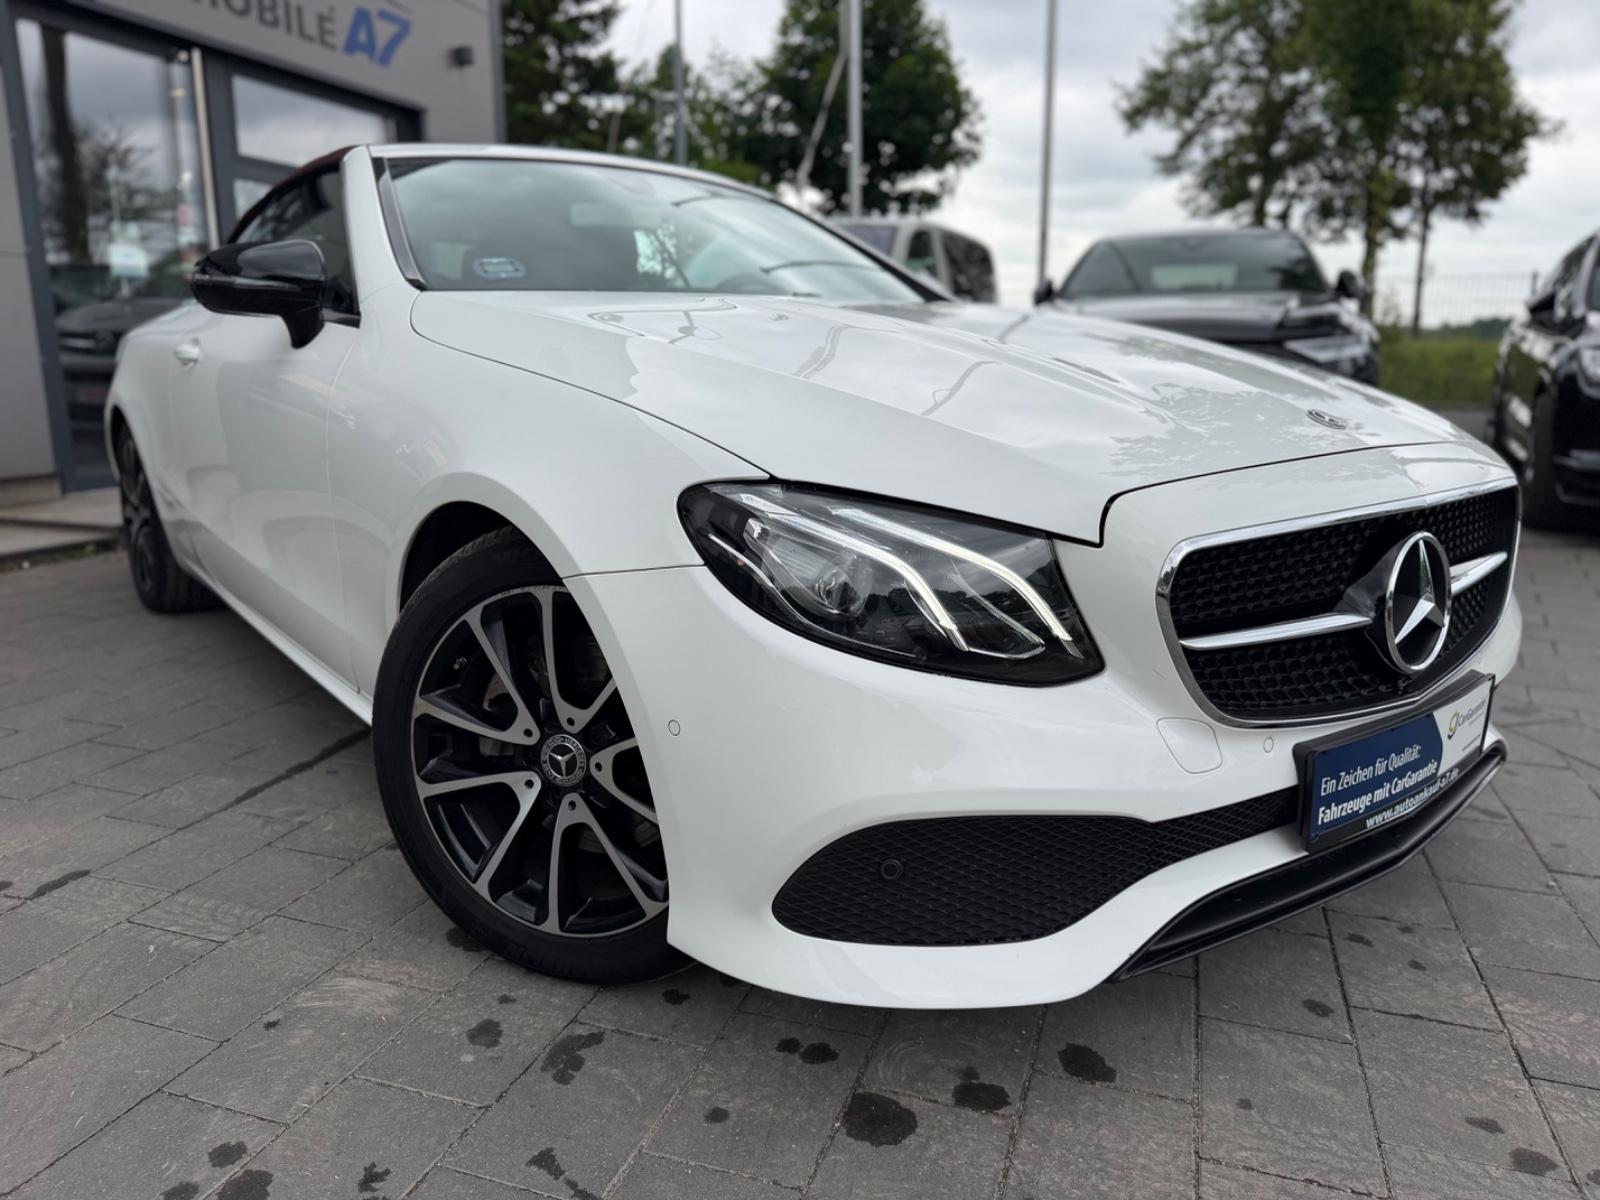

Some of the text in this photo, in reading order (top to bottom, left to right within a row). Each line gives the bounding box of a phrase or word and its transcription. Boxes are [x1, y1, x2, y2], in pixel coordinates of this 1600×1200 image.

[342, 6, 412, 69] A7
[1317, 759, 1438, 826] Fahrzeuge mit CarGarantie
[1321, 777, 1337, 797] Ein
[1337, 765, 1374, 791] Zeichen
[1374, 757, 1388, 777] für
